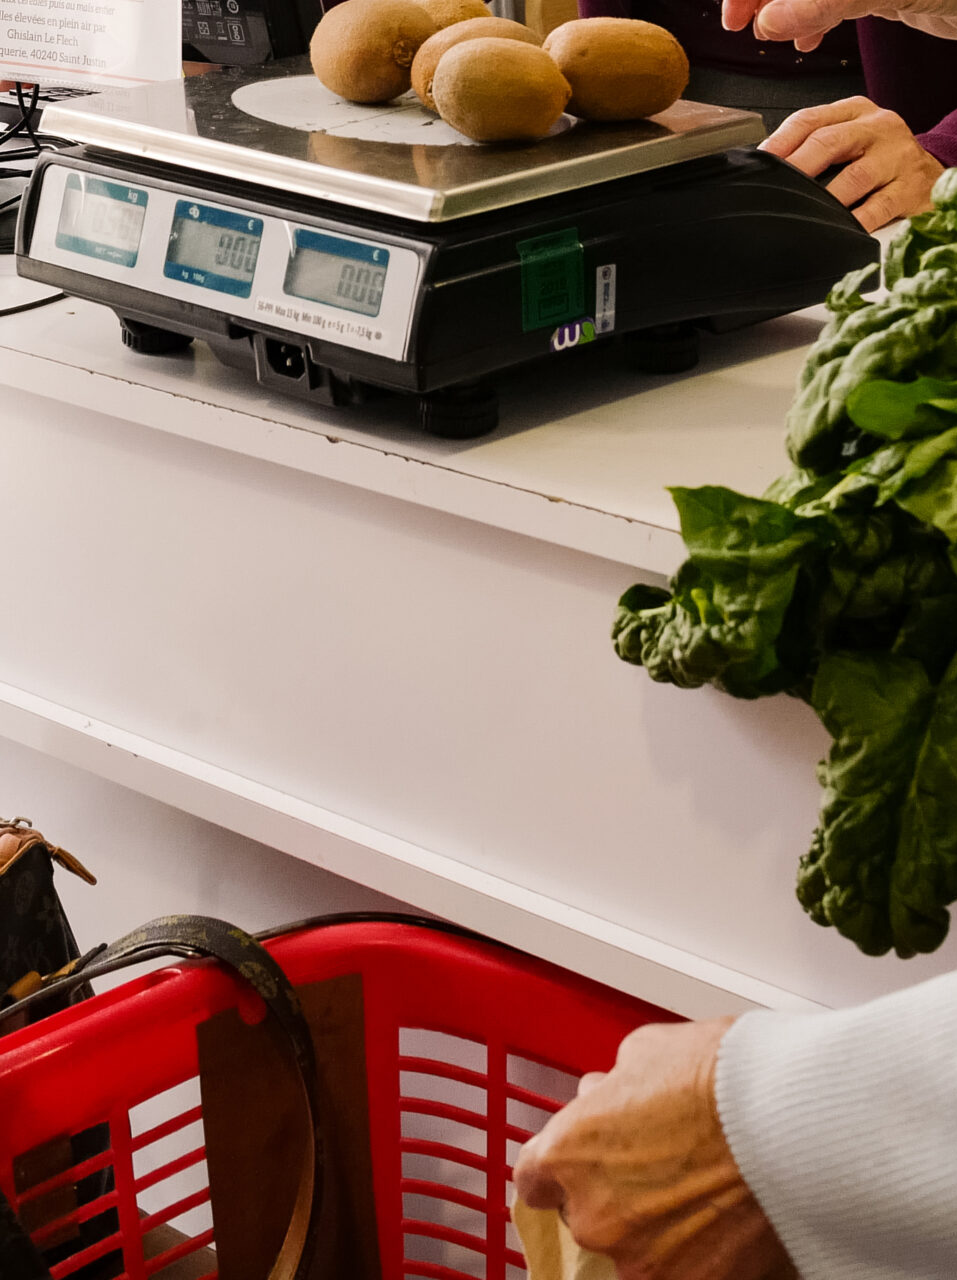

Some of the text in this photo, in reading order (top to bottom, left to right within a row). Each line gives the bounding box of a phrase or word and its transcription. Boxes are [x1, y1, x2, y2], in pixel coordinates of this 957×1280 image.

[14, 11, 46, 25] élevées
[46, 17, 57, 27] en
[58, 17, 79, 30] plein
[80, 22, 91, 32] air
[7, 28, 79, 47] Ghislain Le Flech
[30, 49, 58, 62] 40240
[59, 52, 80, 65] Saint
[127, 188, 139, 203] kg
